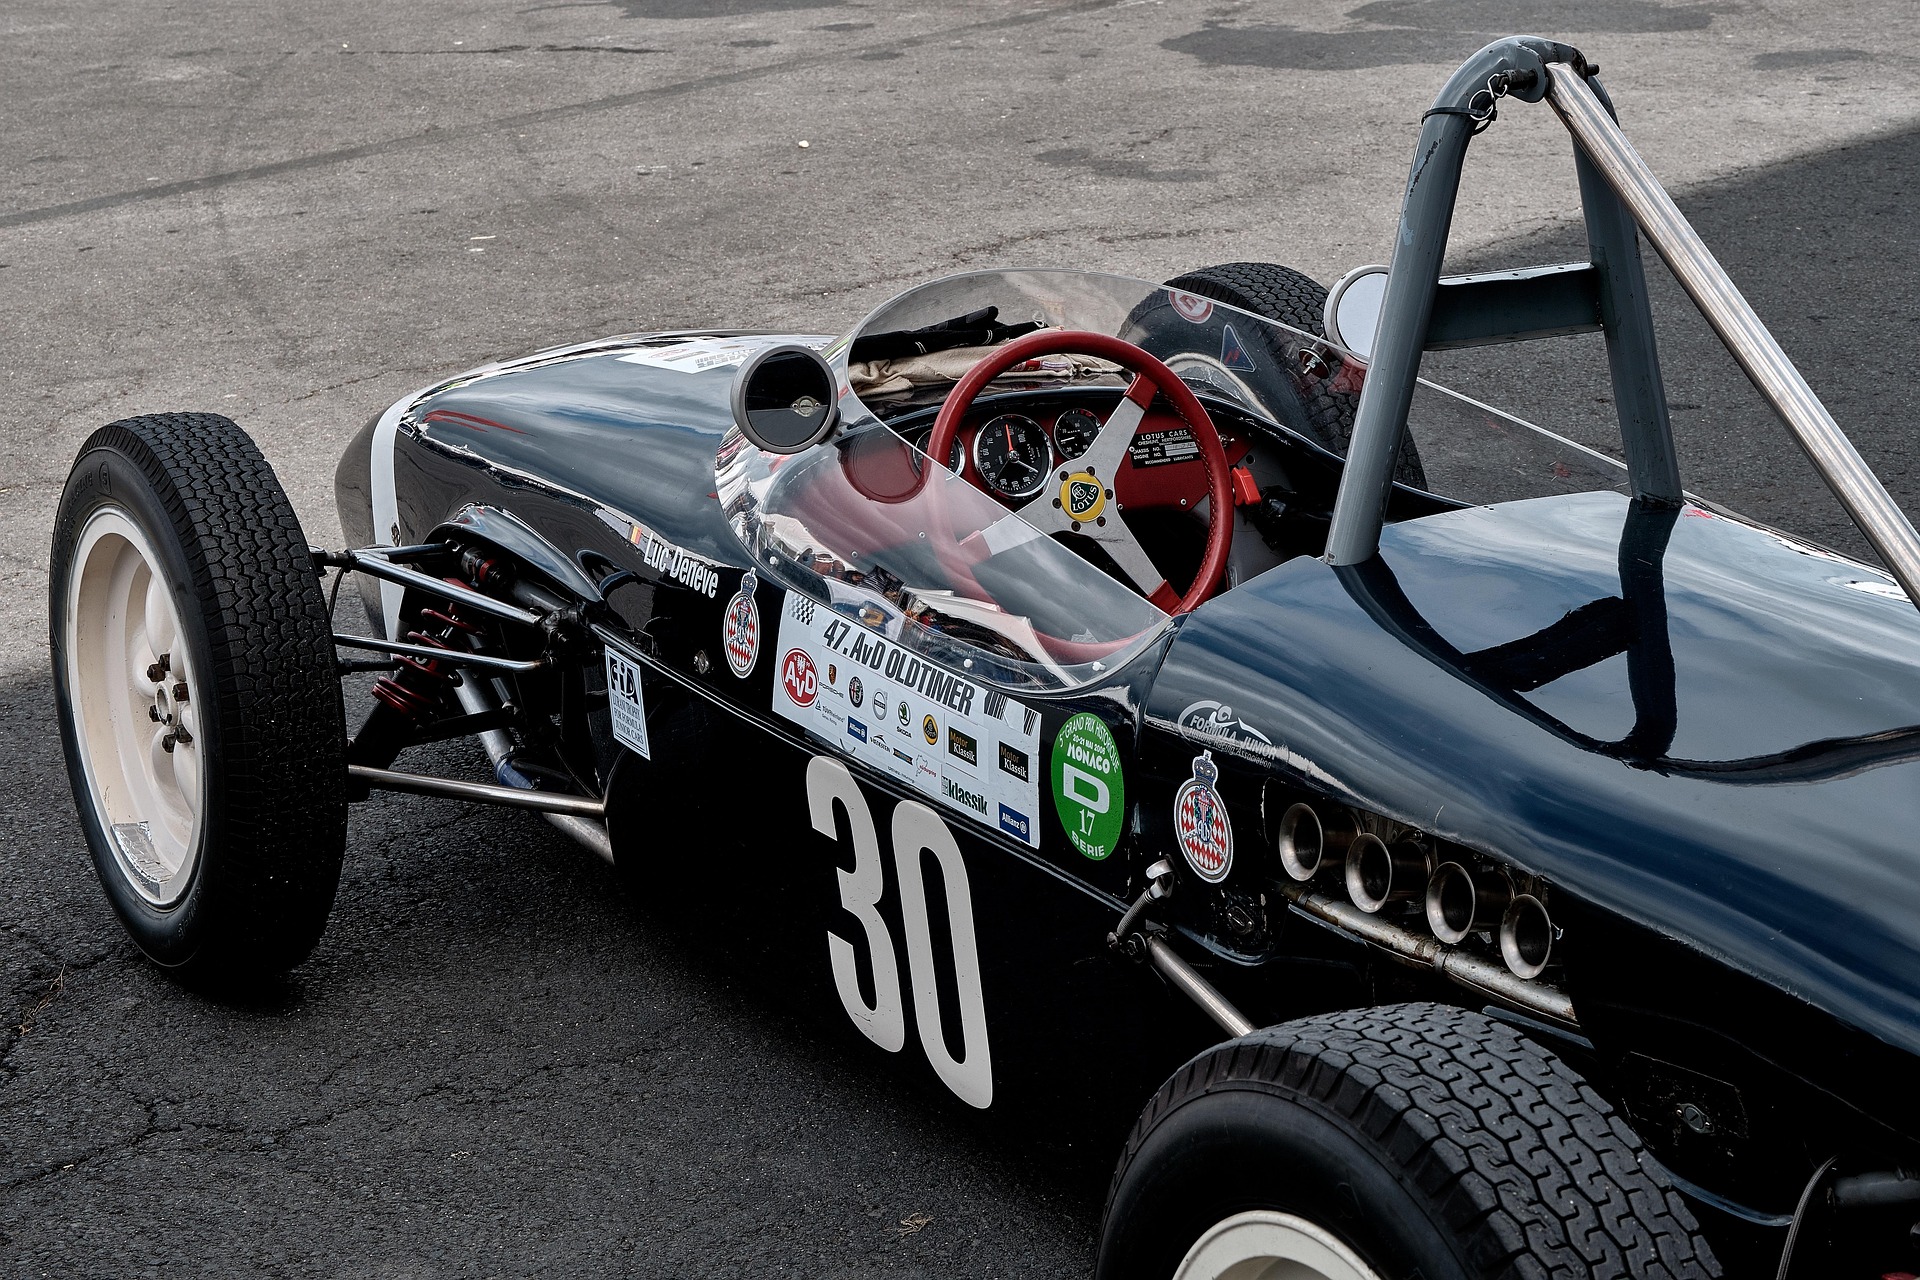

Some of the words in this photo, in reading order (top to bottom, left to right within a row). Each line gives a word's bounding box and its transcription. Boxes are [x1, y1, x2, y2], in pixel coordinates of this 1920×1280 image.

[1141, 432, 1165, 441] LOTUS
[1168, 429, 1188, 438] CARS
[1072, 486, 1098, 511] LOTUS
[644, 532, 669, 573] Luc
[669, 546, 719, 598] Deneve
[785, 660, 817, 698] AvD
[823, 618, 852, 655] 47.
[849, 631, 887, 670] AvD
[885, 648, 976, 716] OLDTIMER
[950, 730, 969, 749] Motor
[1064, 716, 1084, 739] GRAND
[1085, 716, 1095, 734] PRIX
[1094, 722, 1120, 774] HISTORIQUE
[1072, 733, 1086, 746] 20-21
[1190, 714, 1238, 745] FORMULA
[1242, 736, 1278, 760] JUNIOR
[953, 742, 976, 763] Klassik
[1000, 745, 1020, 764] Motor
[1067, 742, 1111, 775] MONACO
[1213, 737, 1235, 756] Racing
[1236, 746, 1272, 769] Association
[1004, 757, 1027, 779] Klassik
[948, 777, 988, 816] klassik
[1063, 762, 1110, 814] D
[1001, 812, 1021, 830] Allianz
[1079, 808, 1096, 837] 17
[1071, 830, 1105, 857] SERIE
[806, 755, 992, 1109] 30
